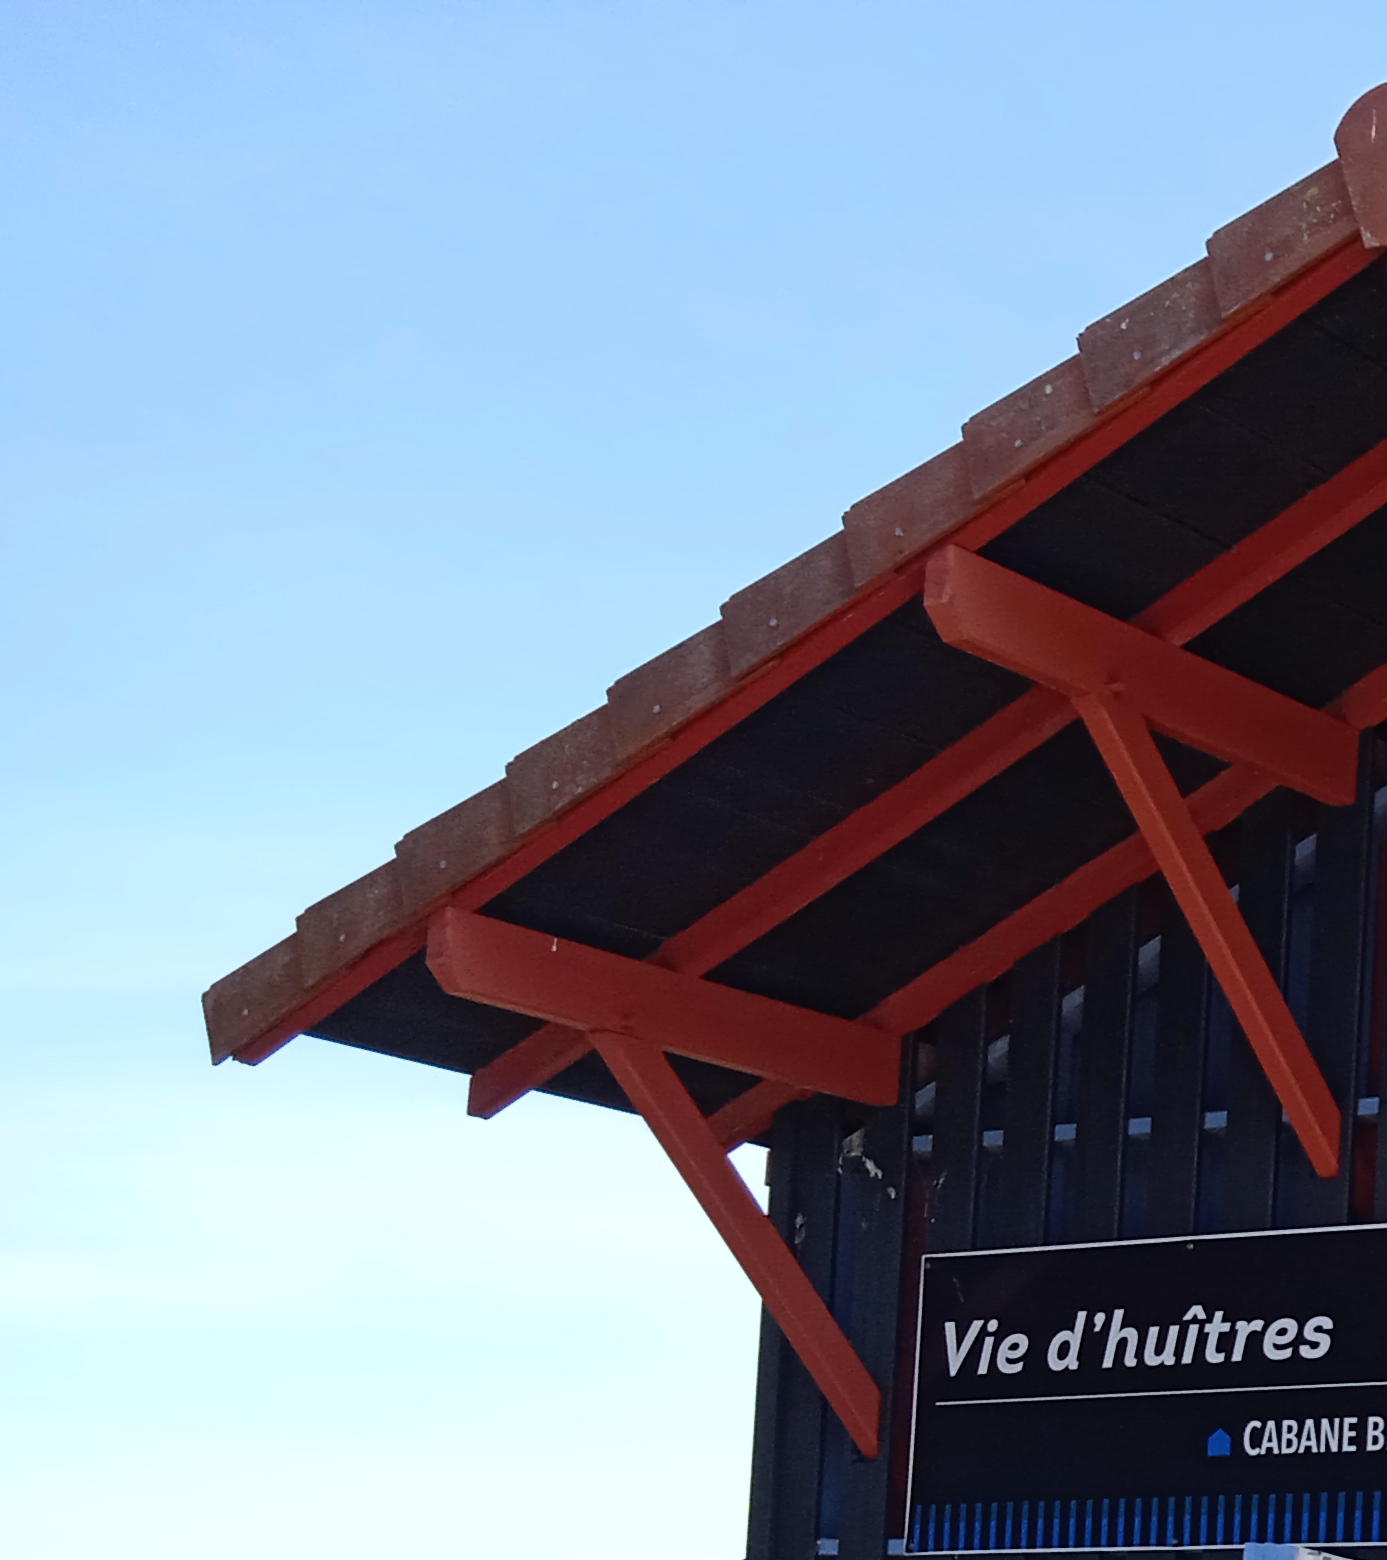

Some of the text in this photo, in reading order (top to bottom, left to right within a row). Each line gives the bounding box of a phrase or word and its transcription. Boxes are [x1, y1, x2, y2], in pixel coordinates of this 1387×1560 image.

[943, 1304, 1334, 1378] Vie d'huîtres
[1242, 1416, 1359, 1457] CABANE
